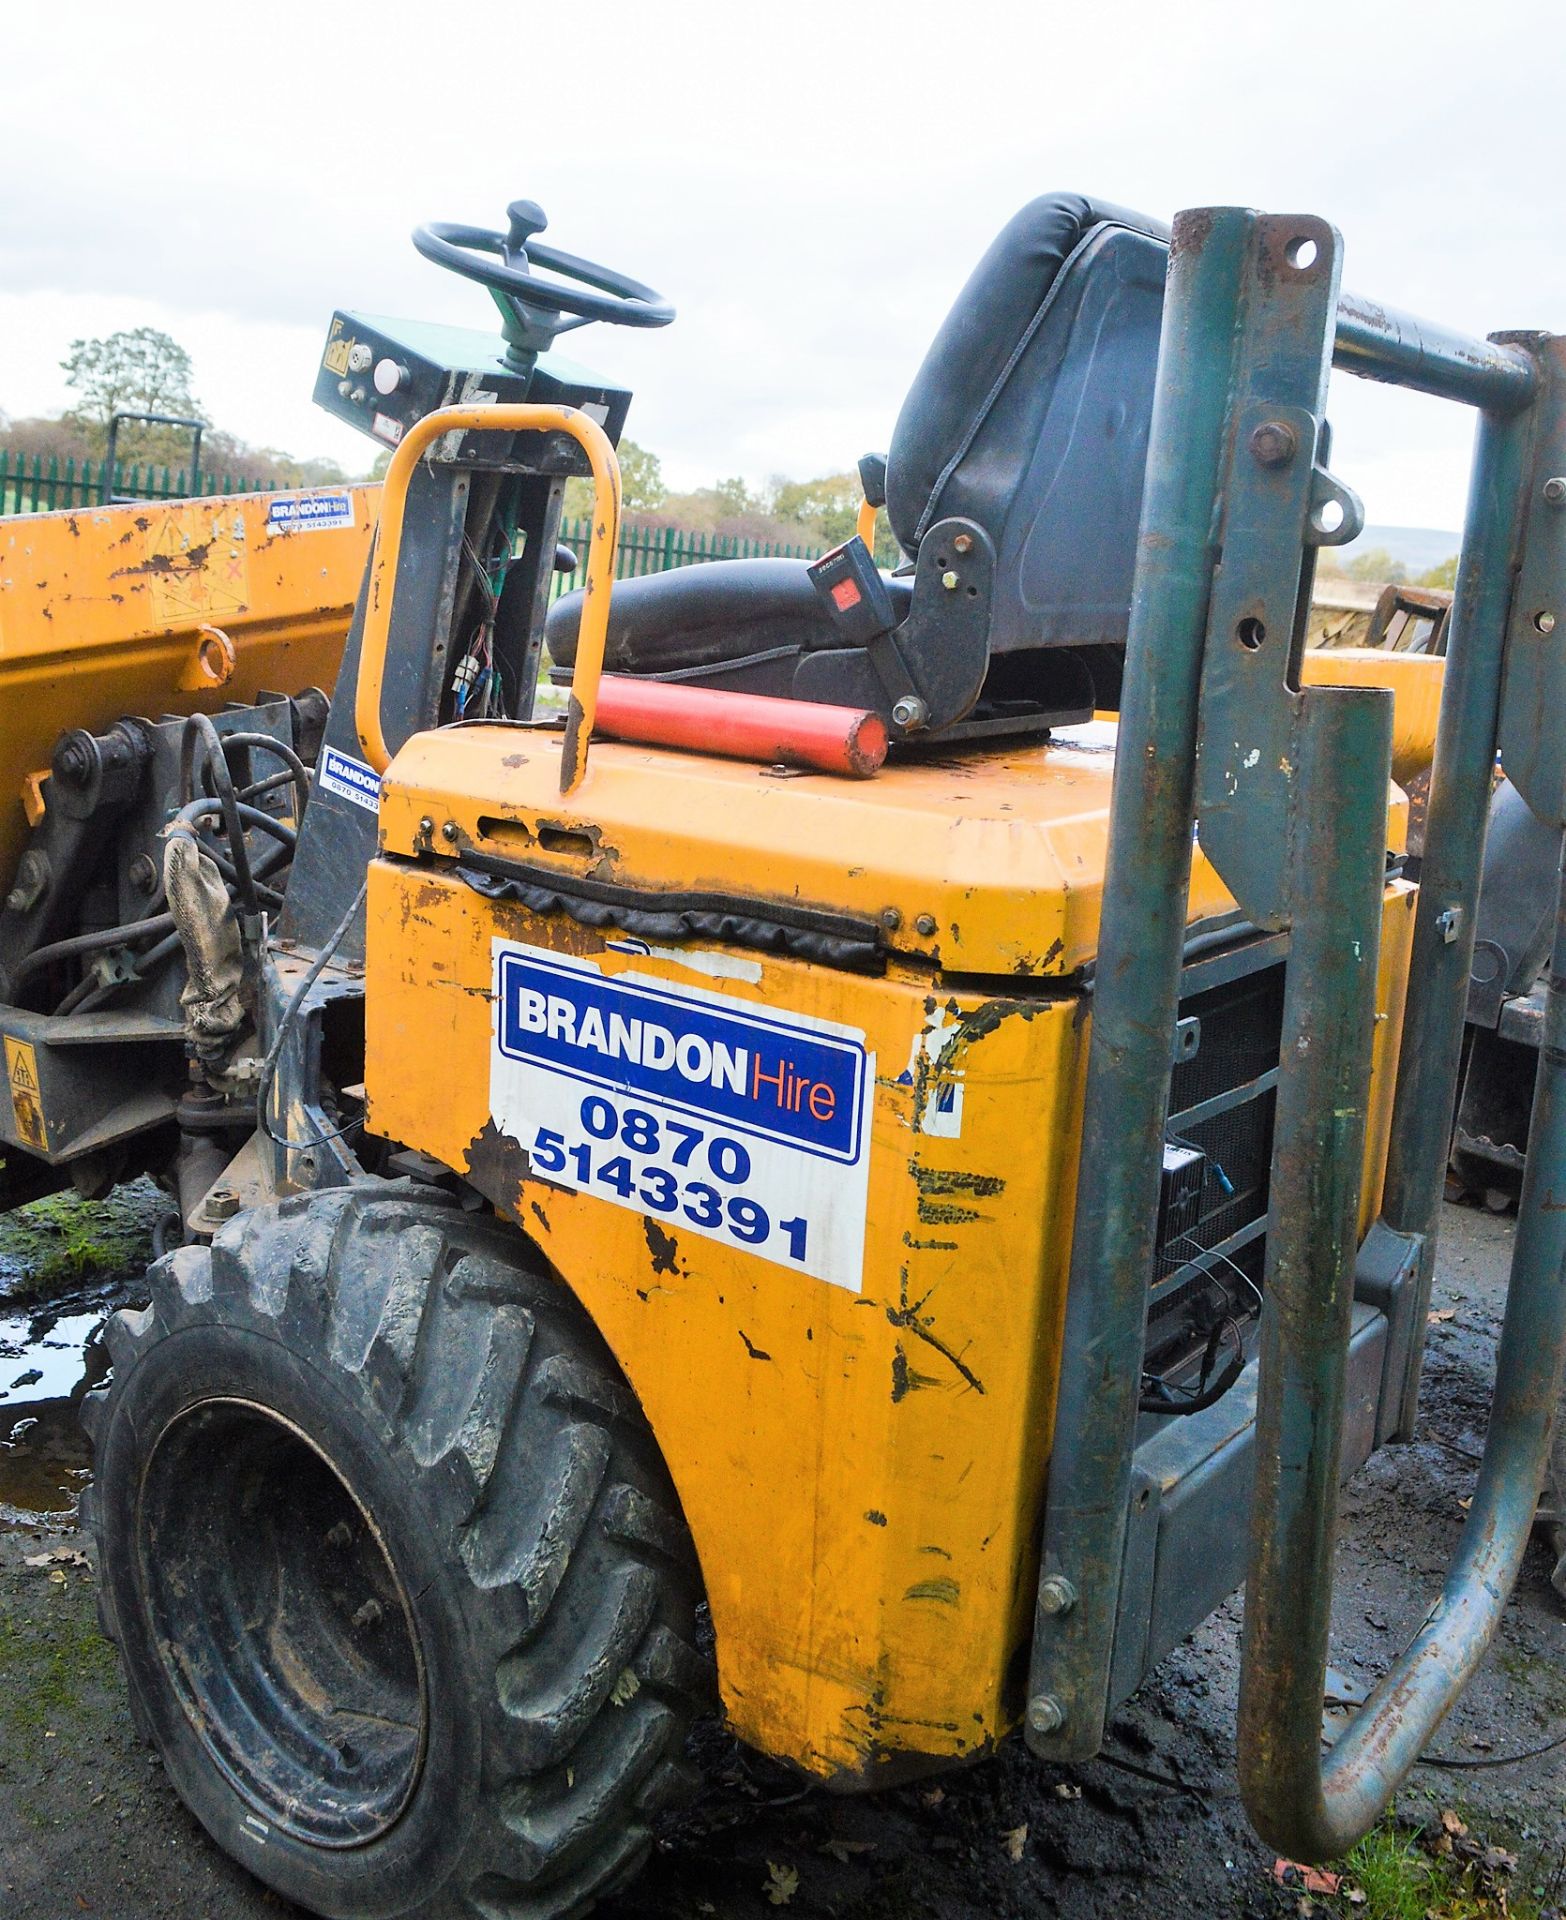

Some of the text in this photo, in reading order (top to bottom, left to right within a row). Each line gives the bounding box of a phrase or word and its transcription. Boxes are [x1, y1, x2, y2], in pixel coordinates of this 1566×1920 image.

[328, 758, 379, 794] BRANDON
[332, 782, 352, 795] 0870
[580, 1095, 752, 1185] 0870
[531, 1126, 809, 1262] 5143391
